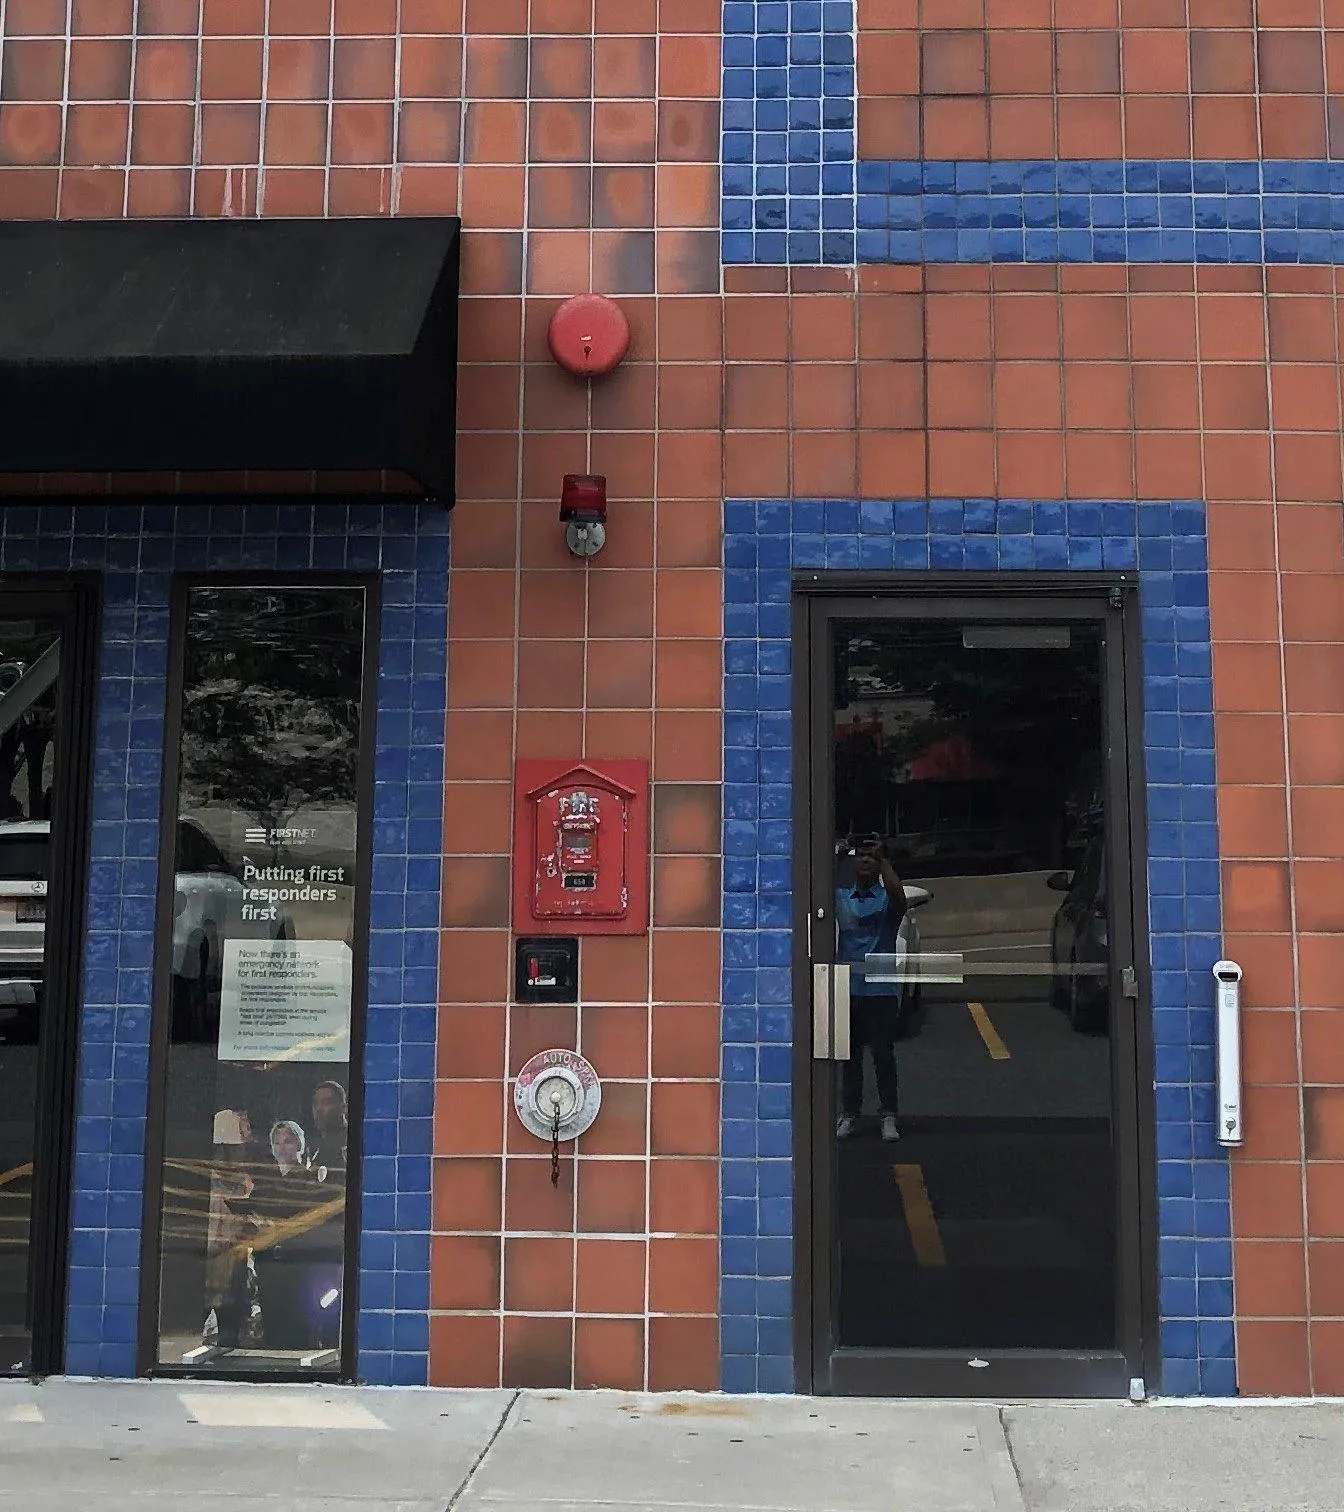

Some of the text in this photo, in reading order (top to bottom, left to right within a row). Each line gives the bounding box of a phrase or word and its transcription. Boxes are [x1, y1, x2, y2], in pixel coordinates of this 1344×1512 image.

[244, 865, 345, 884] Putting first
[242, 885, 337, 904] responders
[241, 904, 277, 920] first
